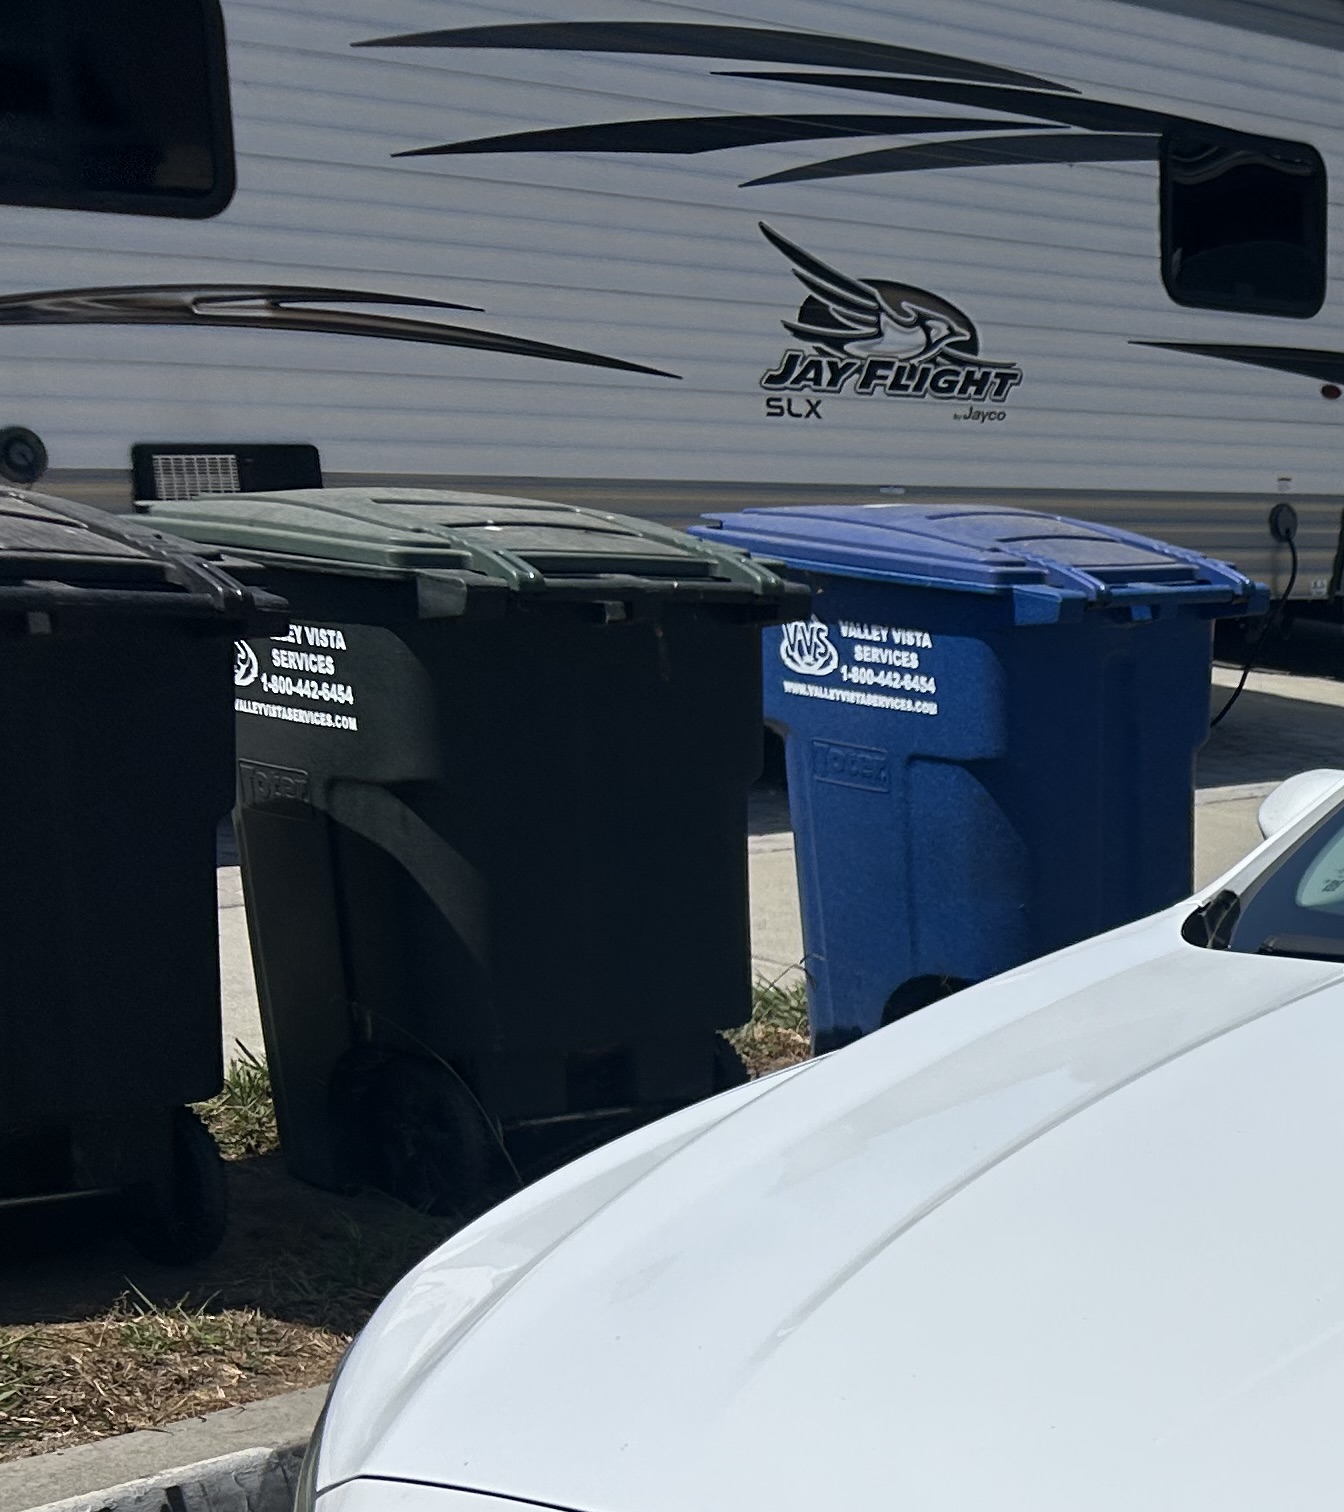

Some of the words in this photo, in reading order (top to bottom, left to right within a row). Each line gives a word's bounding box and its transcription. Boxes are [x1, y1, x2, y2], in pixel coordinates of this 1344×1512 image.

[759, 349, 861, 393] JAY
[854, 356, 1023, 402] FLIGHT
[765, 397, 822, 419] SLX
[963, 406, 1006, 423] Jayco
[304, 626, 347, 650] VISTA
[838, 619, 888, 643] VALLEY
[891, 627, 933, 649] VISTA
[271, 648, 336, 676] SERVICES
[853, 643, 919, 669] SERVICES
[260, 672, 354, 706] 1-800-442-6454
[840, 665, 937, 695] 1-800-442-6454
